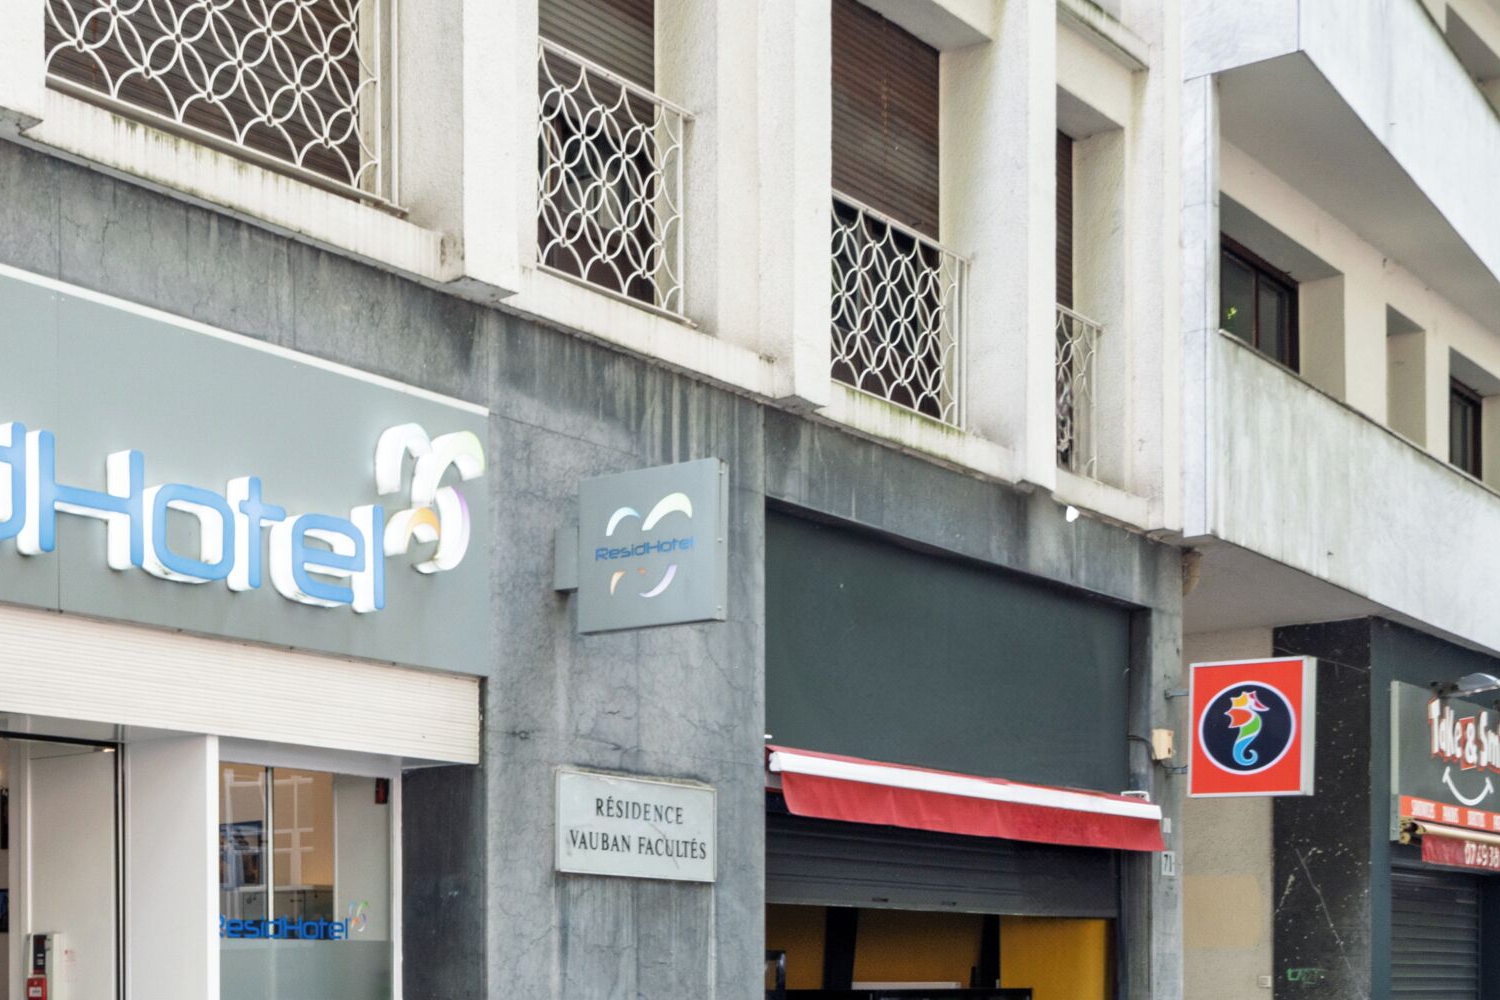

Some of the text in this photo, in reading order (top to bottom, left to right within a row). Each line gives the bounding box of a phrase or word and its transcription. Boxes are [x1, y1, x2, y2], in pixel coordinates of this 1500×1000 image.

[595, 536, 694, 561] ResidHotel
[595, 796, 684, 825] RÉSIDENCE
[570, 829, 706, 860] VAUBAN FACULTÉS
